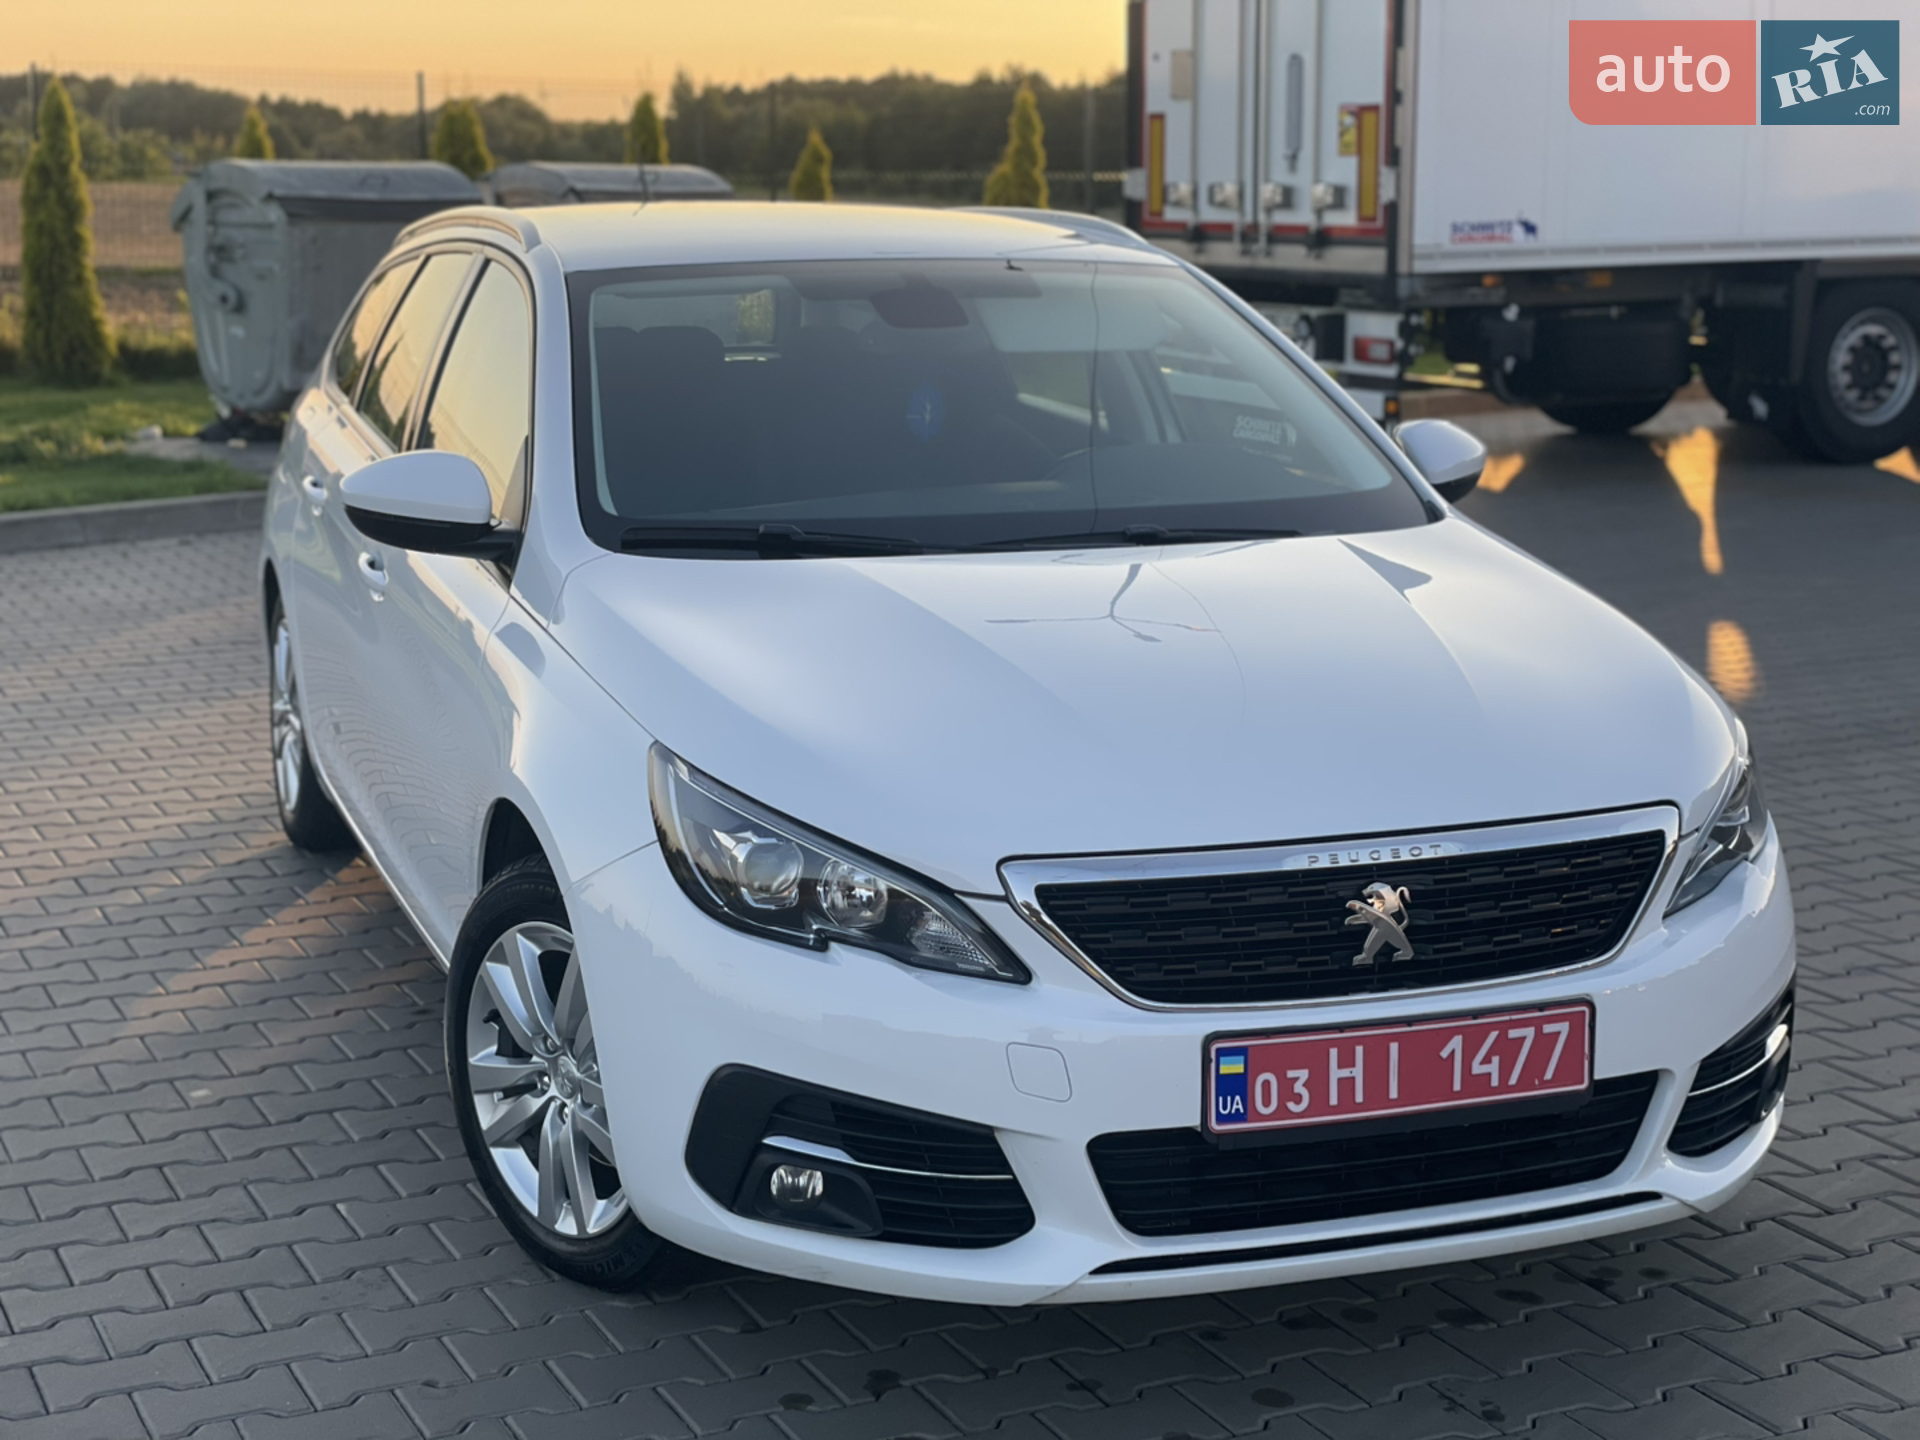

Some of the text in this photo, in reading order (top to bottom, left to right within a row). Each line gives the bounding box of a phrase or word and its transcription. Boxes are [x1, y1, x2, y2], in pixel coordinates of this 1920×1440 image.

[1306, 844, 1442, 867] PEUGEOT
[1254, 1068, 1310, 1116] 03
[1439, 1021, 1571, 1092] 1477
[1218, 1095, 1245, 1115] UA
